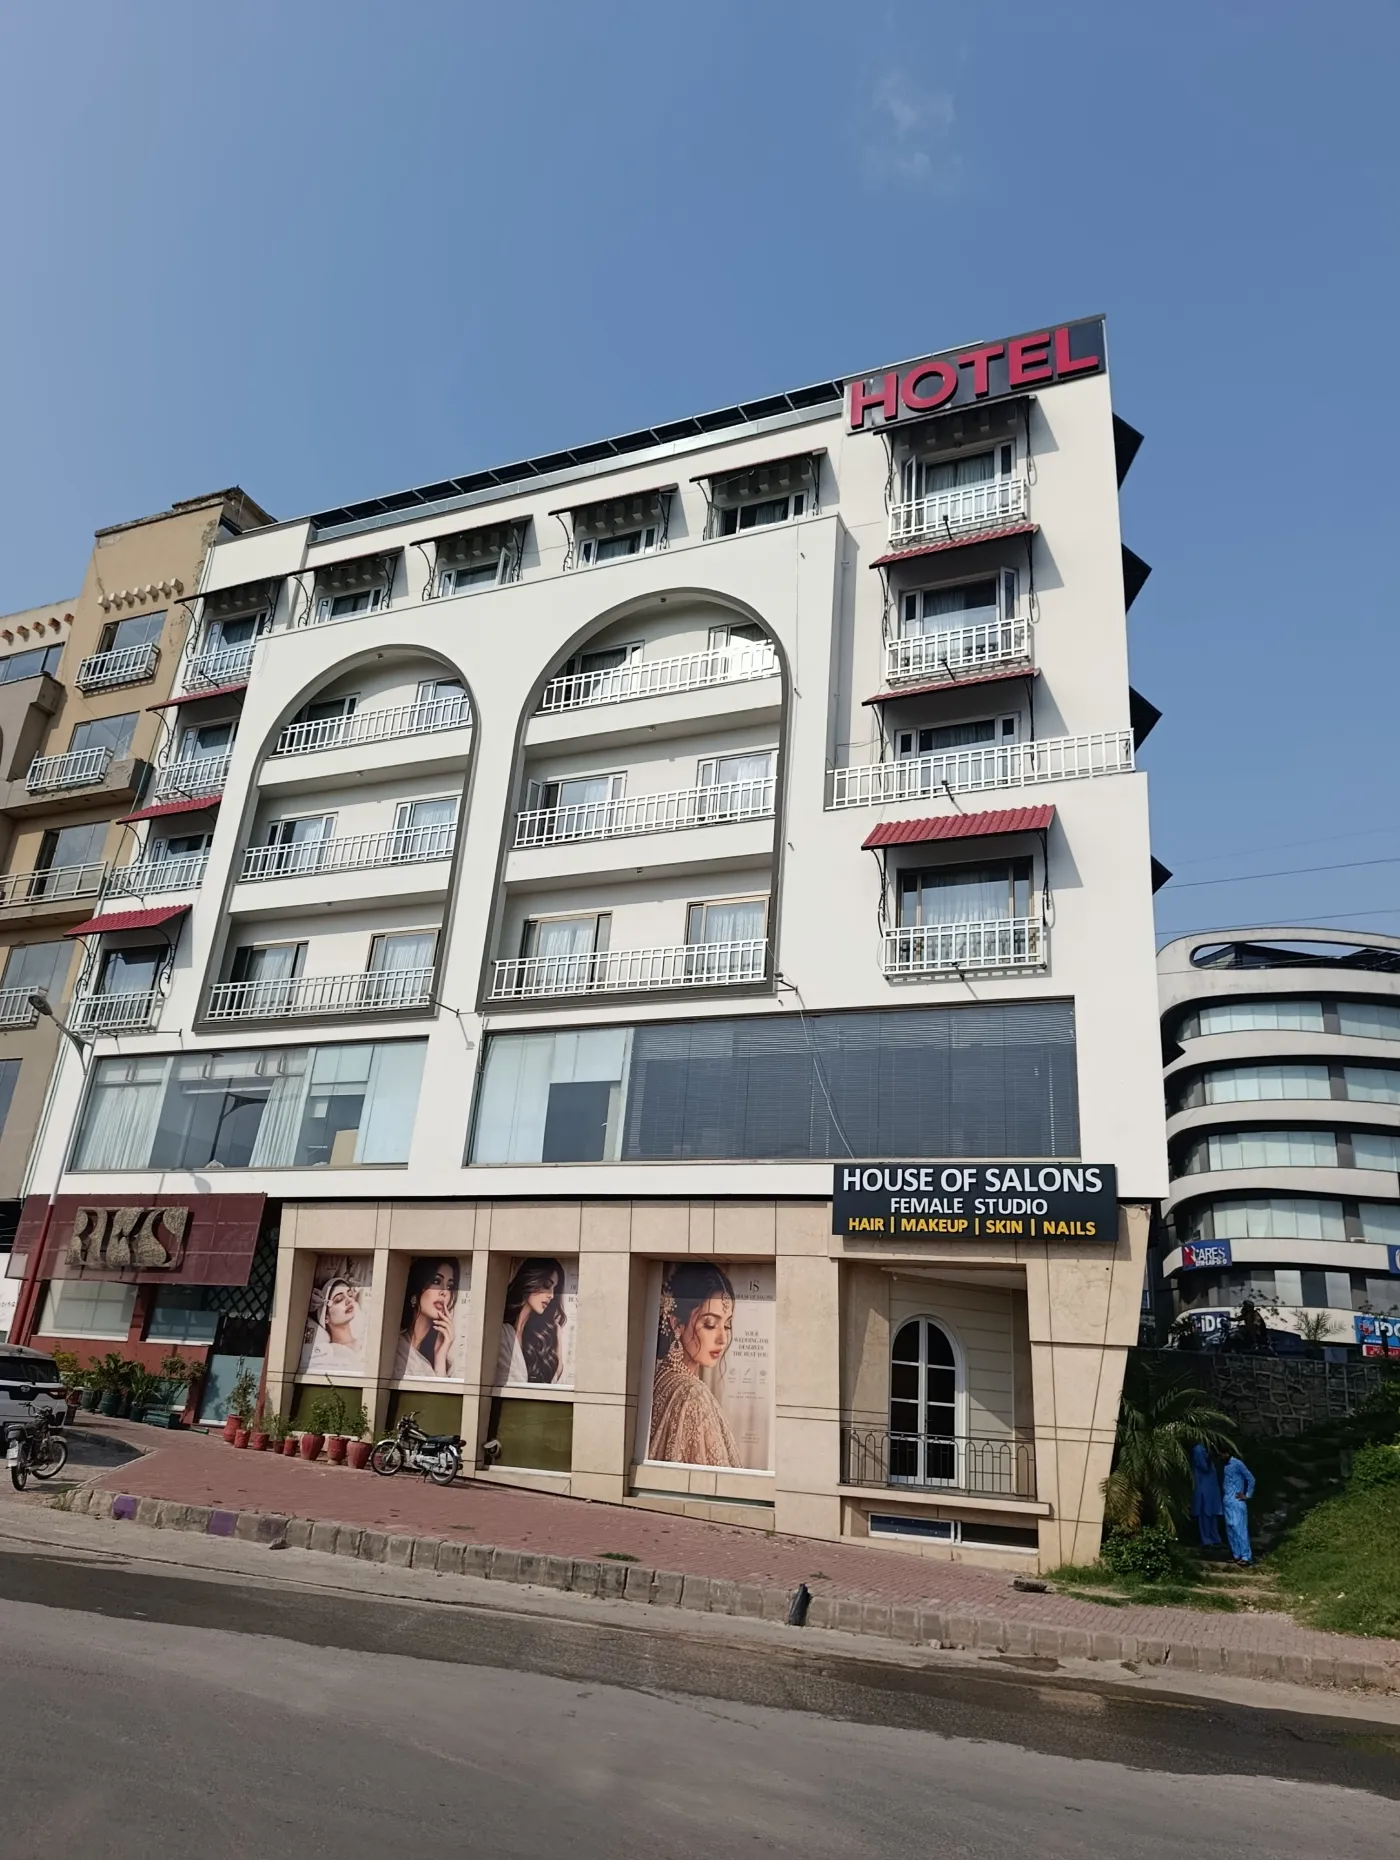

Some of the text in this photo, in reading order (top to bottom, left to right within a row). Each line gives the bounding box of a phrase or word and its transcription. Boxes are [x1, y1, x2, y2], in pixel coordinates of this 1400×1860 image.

[850, 327, 1099, 430] HOTEL
[843, 1167, 1103, 1193] HOUSE OF SALONS
[890, 1197, 1048, 1215] FEMALE STUDIO
[848, 1217, 1096, 1236] HAIR MAKEUP SKIN NAILS
